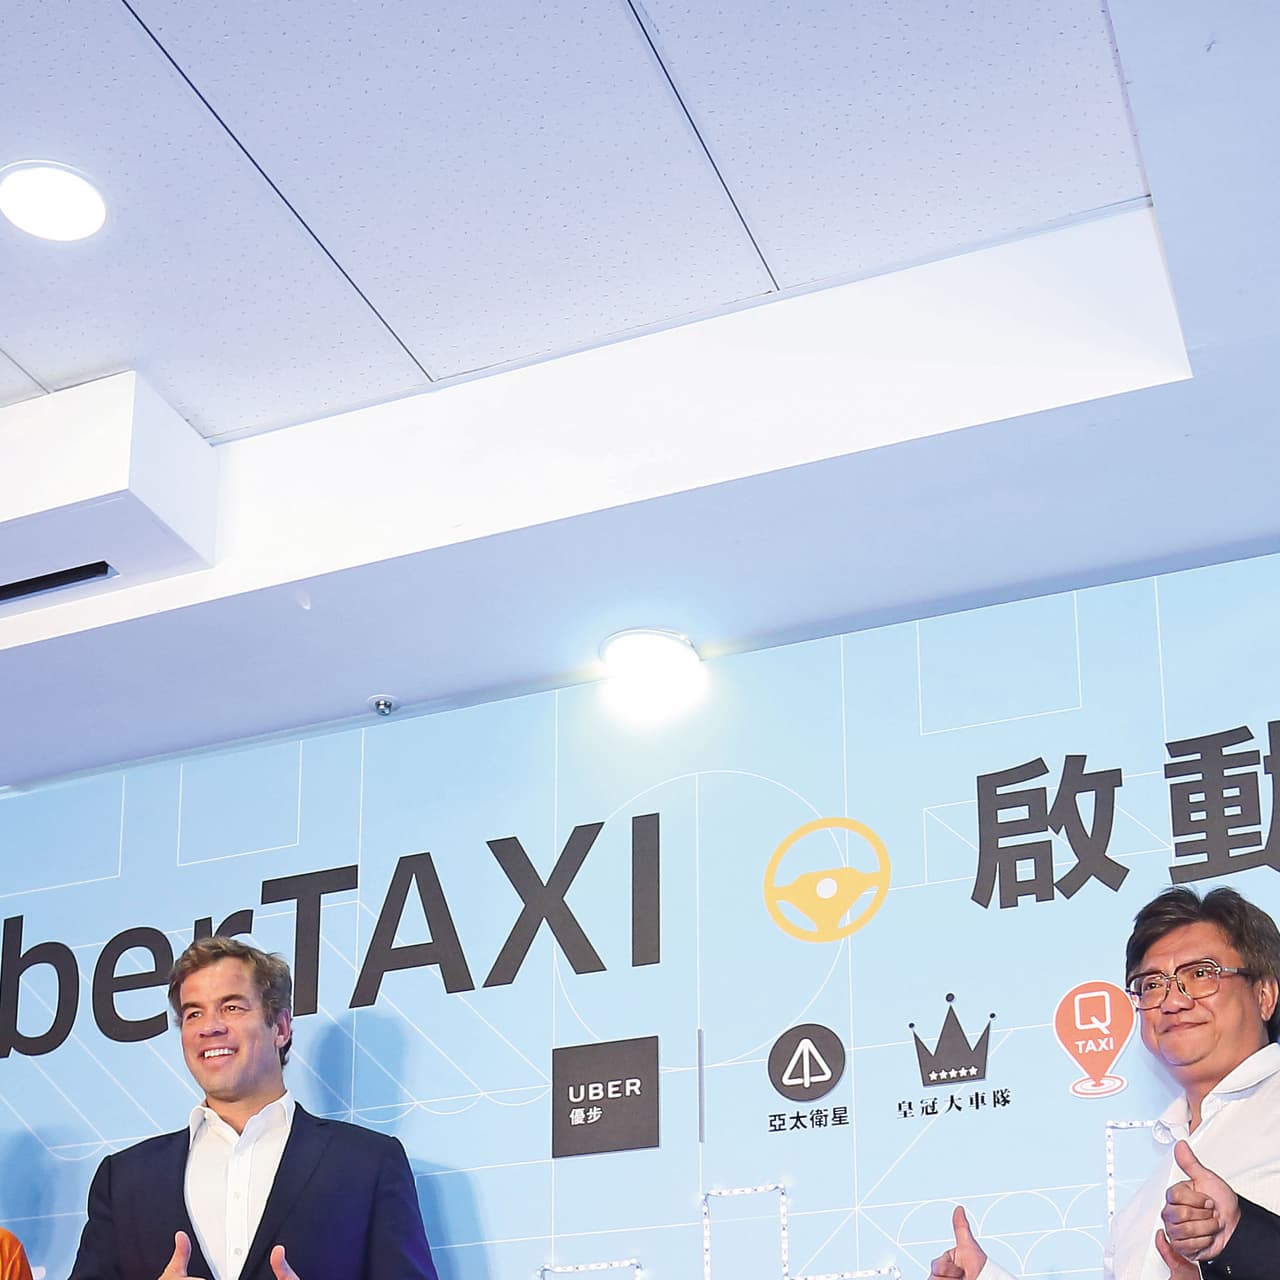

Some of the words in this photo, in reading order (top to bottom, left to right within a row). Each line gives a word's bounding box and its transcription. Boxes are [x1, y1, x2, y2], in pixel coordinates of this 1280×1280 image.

[1074, 990, 1112, 1034] Q
[1075, 1037, 1114, 1054] TAXI
[568, 1078, 641, 1103] UBER
[569, 1106, 603, 1126] 優步
[896, 1088, 1012, 1120] 皇冠大車隊
[768, 1106, 850, 1133] 亞太衛星
